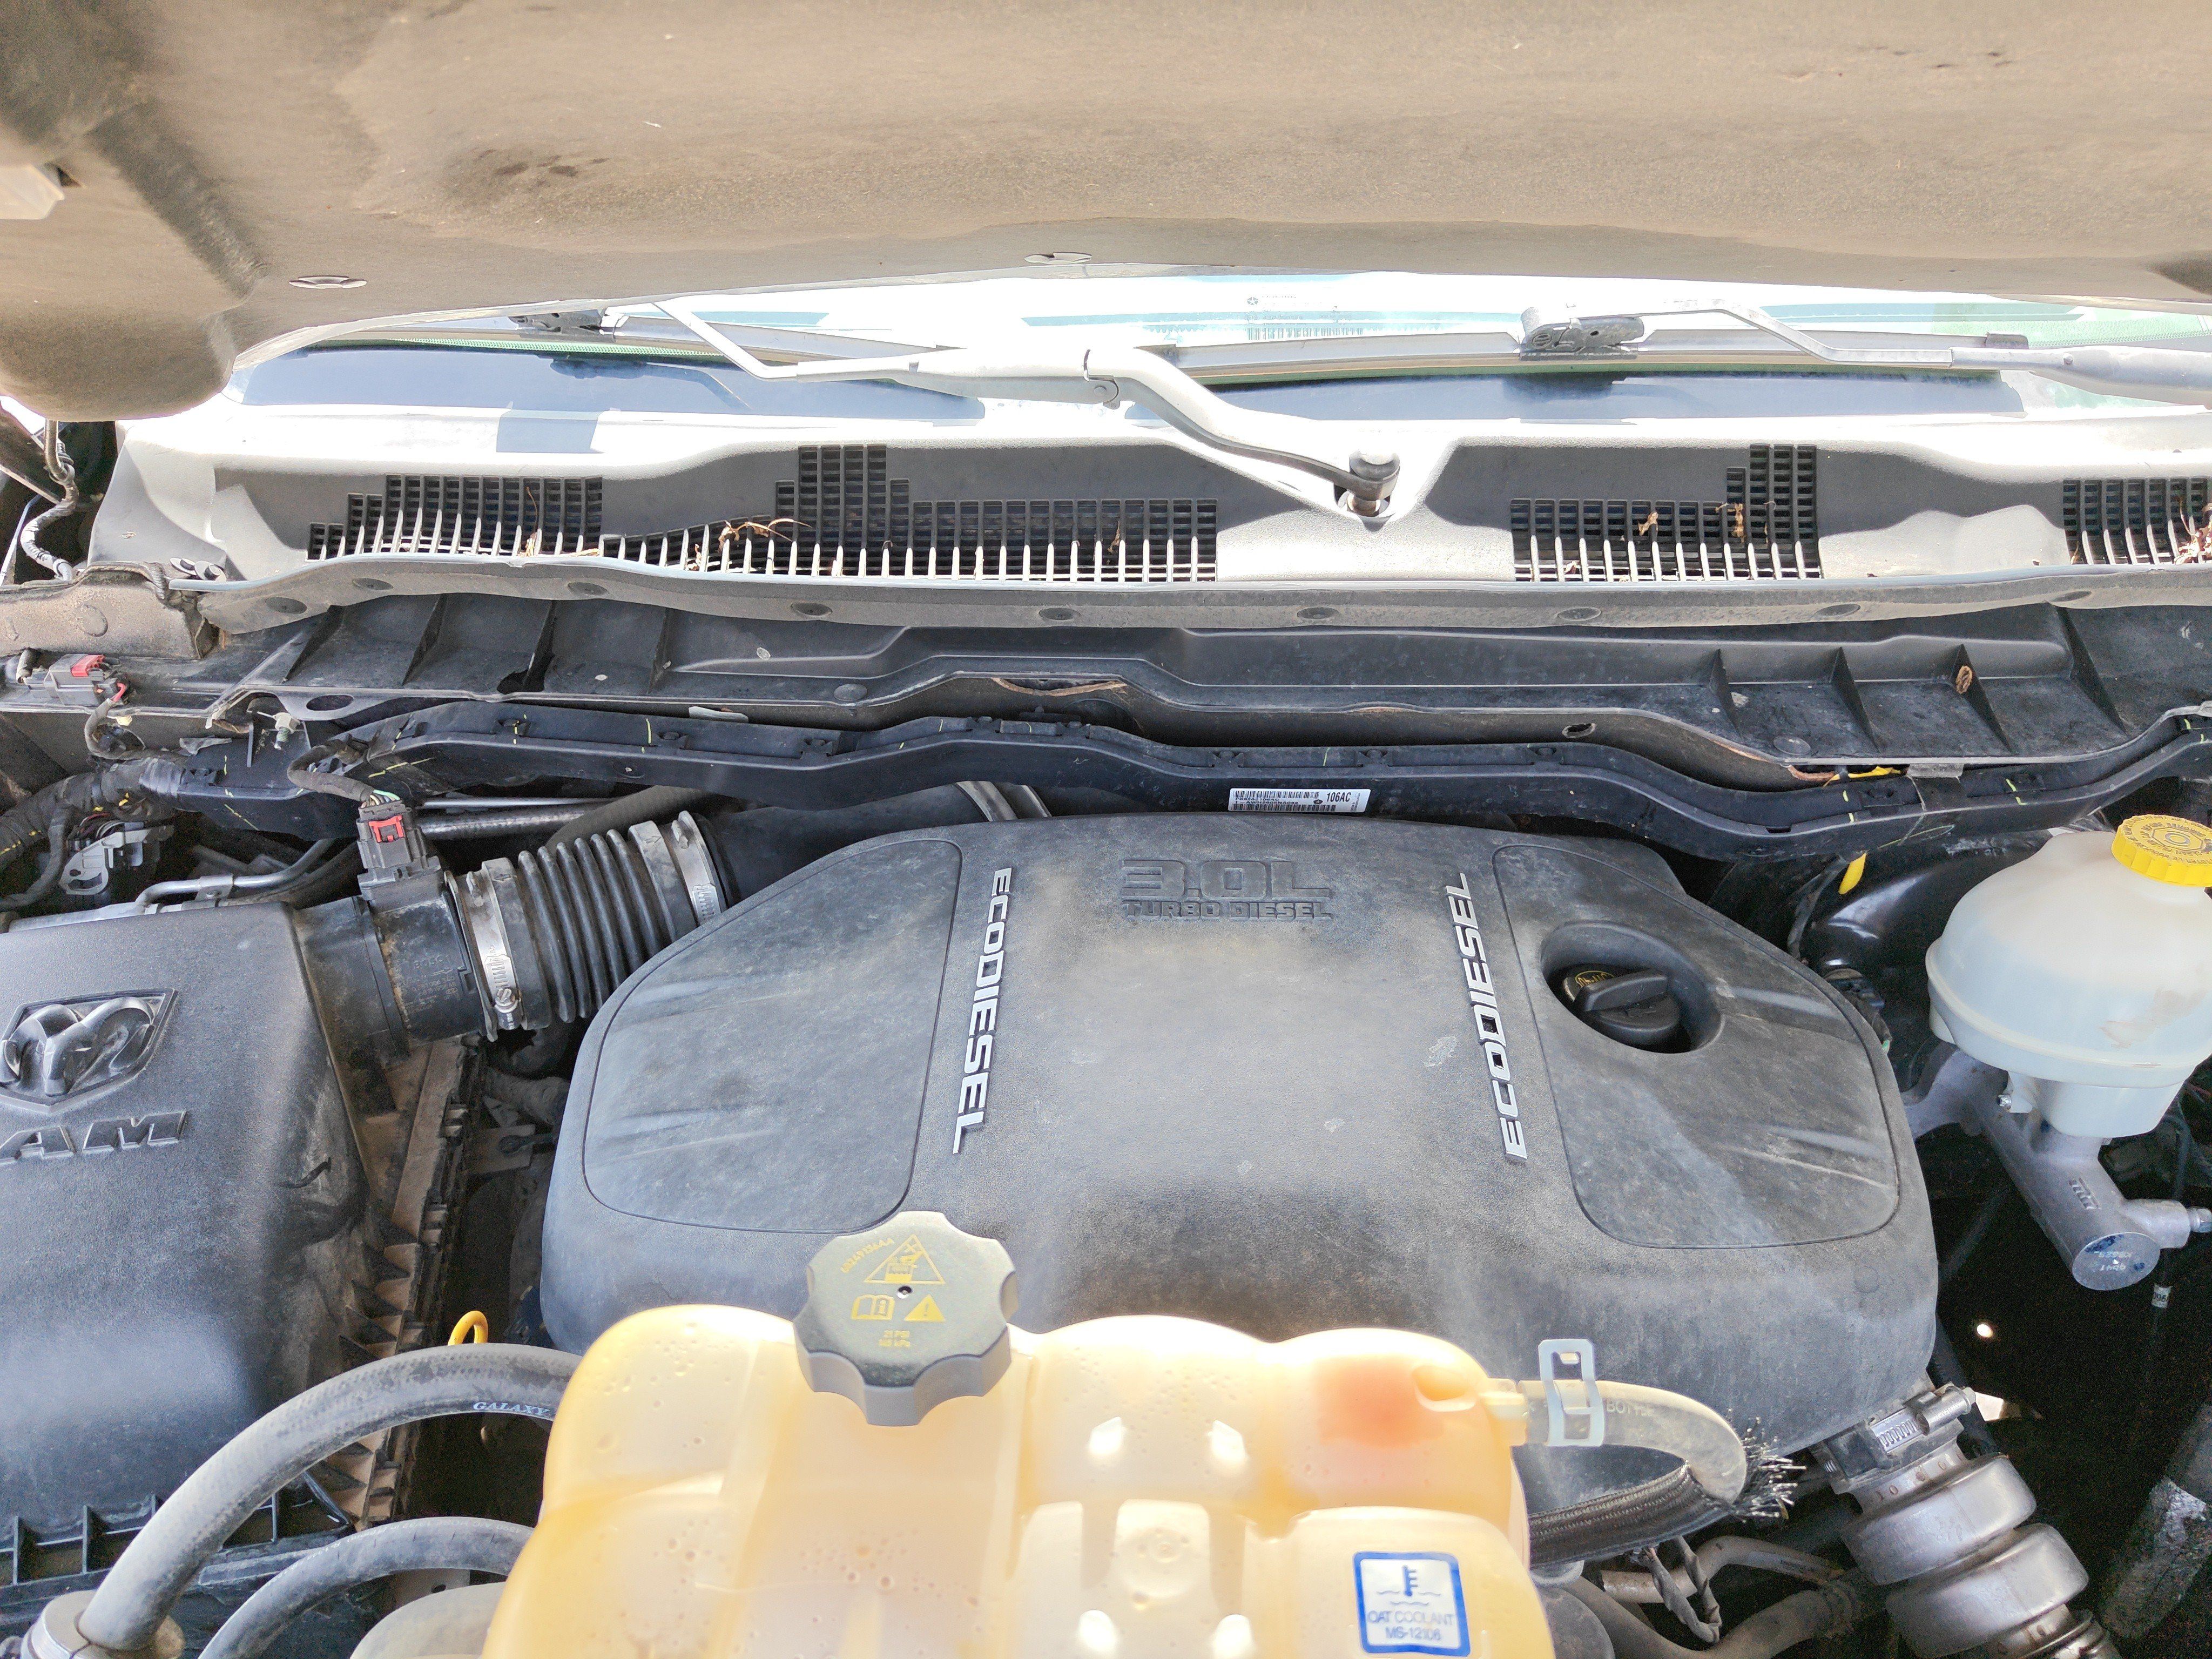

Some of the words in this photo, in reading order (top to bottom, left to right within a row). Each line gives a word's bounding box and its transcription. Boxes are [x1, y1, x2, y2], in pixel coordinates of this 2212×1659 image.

[1326, 792, 1352, 802] 106AC
[1122, 858, 1333, 900] 3.0L
[1122, 900, 1222, 921] TURBO
[1229, 900, 1332, 921] DIESEL
[952, 866, 1013, 1155] ECODIESEL
[1445, 872, 1528, 1161] ECODIESEL
[0, 1110, 188, 1165] AM
[472, 1400, 550, 1416] GALAXY
[1367, 1610, 1393, 1623] OAT
[1394, 1610, 1454, 1626] COOLANT
